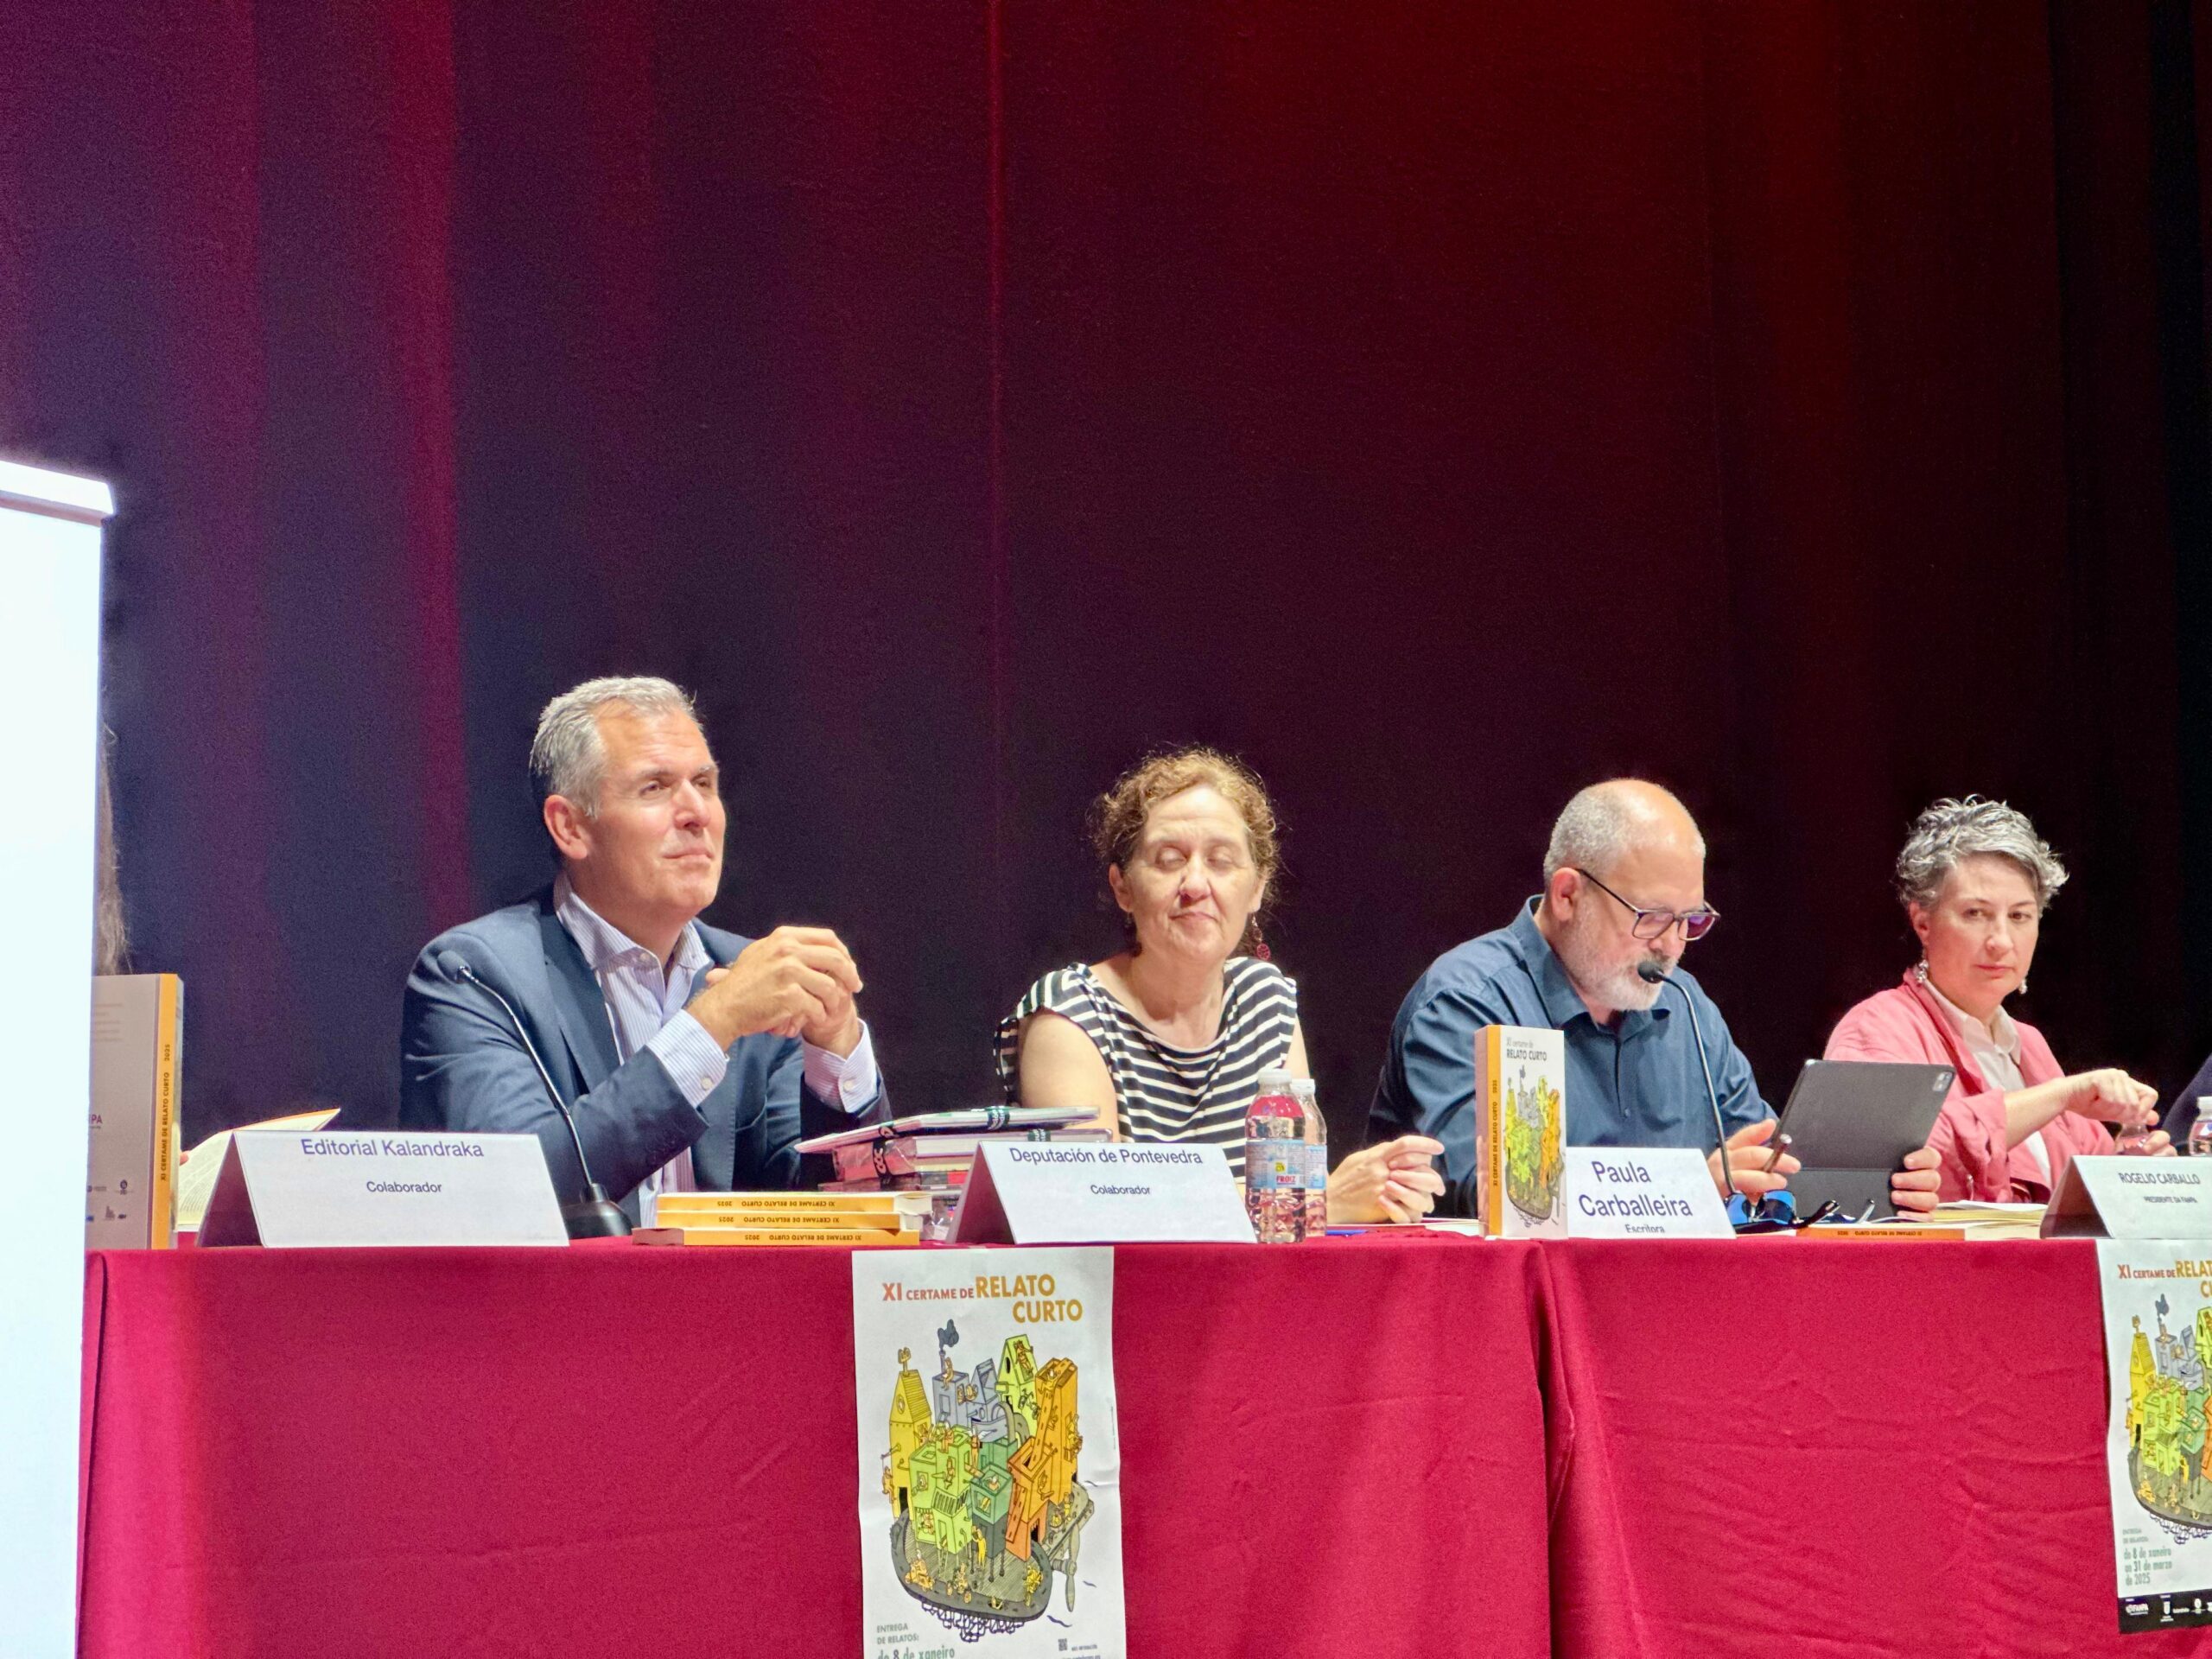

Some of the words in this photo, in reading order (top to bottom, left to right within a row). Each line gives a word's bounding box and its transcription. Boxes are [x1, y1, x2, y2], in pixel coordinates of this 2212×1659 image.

[1506, 1048, 1528, 1060] RELATO
[1529, 1050, 1548, 1062] CURTO
[162, 1127, 168, 1137] DE
[301, 1139, 378, 1156] Editorial
[382, 1140, 485, 1157] Kalandraka
[1009, 1147, 1096, 1165] Deputación
[1098, 1148, 1118, 1163] de
[1119, 1148, 1204, 1164] Pontevedra
[1591, 1160, 1651, 1183] Paula
[2118, 1173, 2157, 1184] ROGELIO
[2157, 1173, 2201, 1185] CARBALLO
[366, 1180, 442, 1193] Colaborador
[1090, 1184, 1151, 1195] Colaborador
[1578, 1193, 1694, 1217] Carballeira
[1624, 1224, 1666, 1234] Escritora
[2117, 1264, 2131, 1279] XI
[2133, 1269, 2165, 1279] CERTAME
[2166, 1269, 2176, 1278] DE
[881, 1282, 902, 1301] XI
[906, 1287, 957, 1300] CERTAME
[960, 1287, 975, 1299] DE
[975, 1274, 1056, 1299] RELATO
[1012, 1299, 1084, 1324] CURTO
[2133, 1560, 2141, 1572] 31
[2143, 1559, 2152, 1571] de
[2152, 1561, 2172, 1571] marzo
[2134, 1573, 2151, 1585] 2025
[876, 1623, 909, 1633] ENTREGA
[877, 1637, 886, 1645] DE
[887, 1633, 919, 1644] RELATOS:
[903, 1646, 915, 1659] de
[918, 1644, 955, 1659] xaneiro
